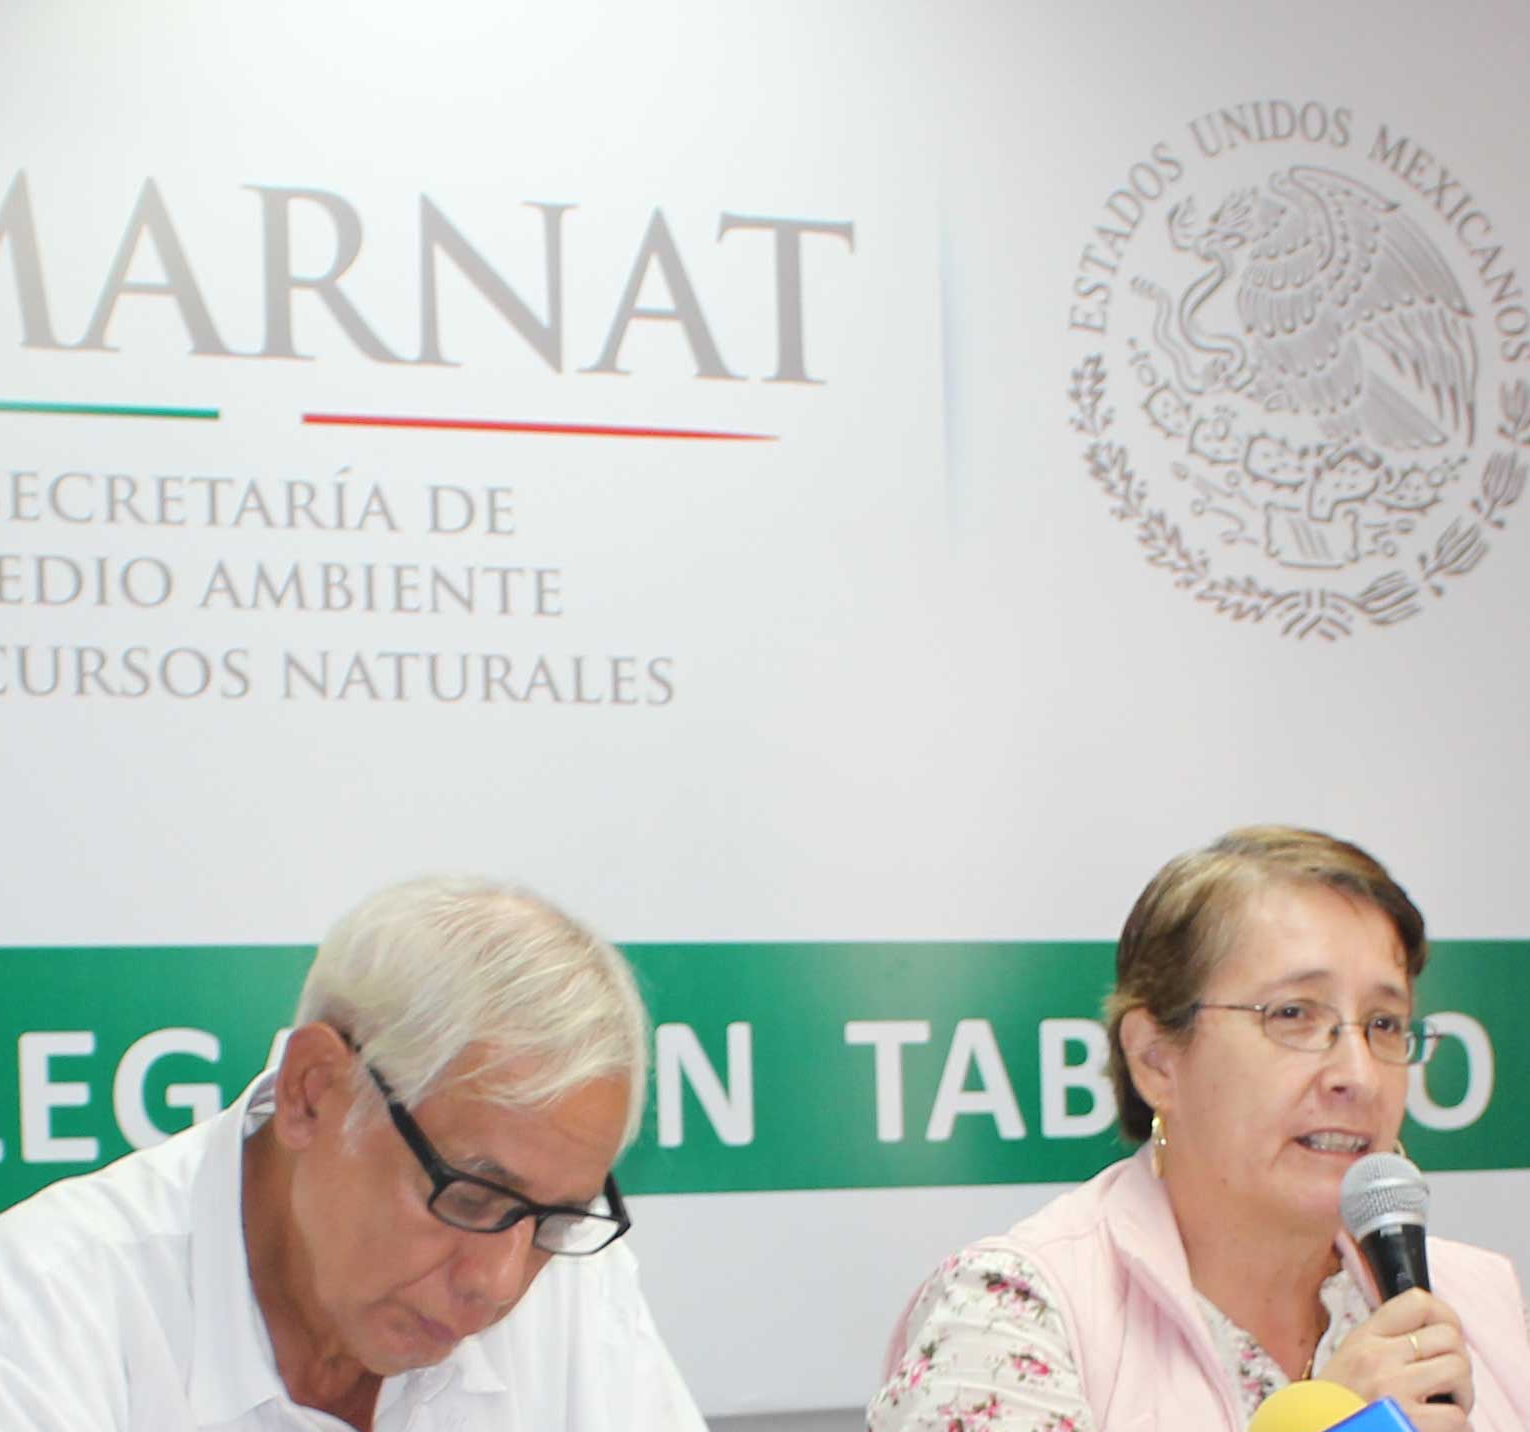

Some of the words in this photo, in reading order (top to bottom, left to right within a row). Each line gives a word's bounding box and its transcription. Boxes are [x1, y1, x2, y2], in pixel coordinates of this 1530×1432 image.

[1070, 142, 1183, 334] ESTADOS
[1187, 100, 1352, 159] UNIDOS
[427, 484, 516, 535] DE
[198, 559, 564, 617] AMBIENTE
[280, 650, 675, 708] NATURALES
[845, 1012, 1494, 1142] TABO
